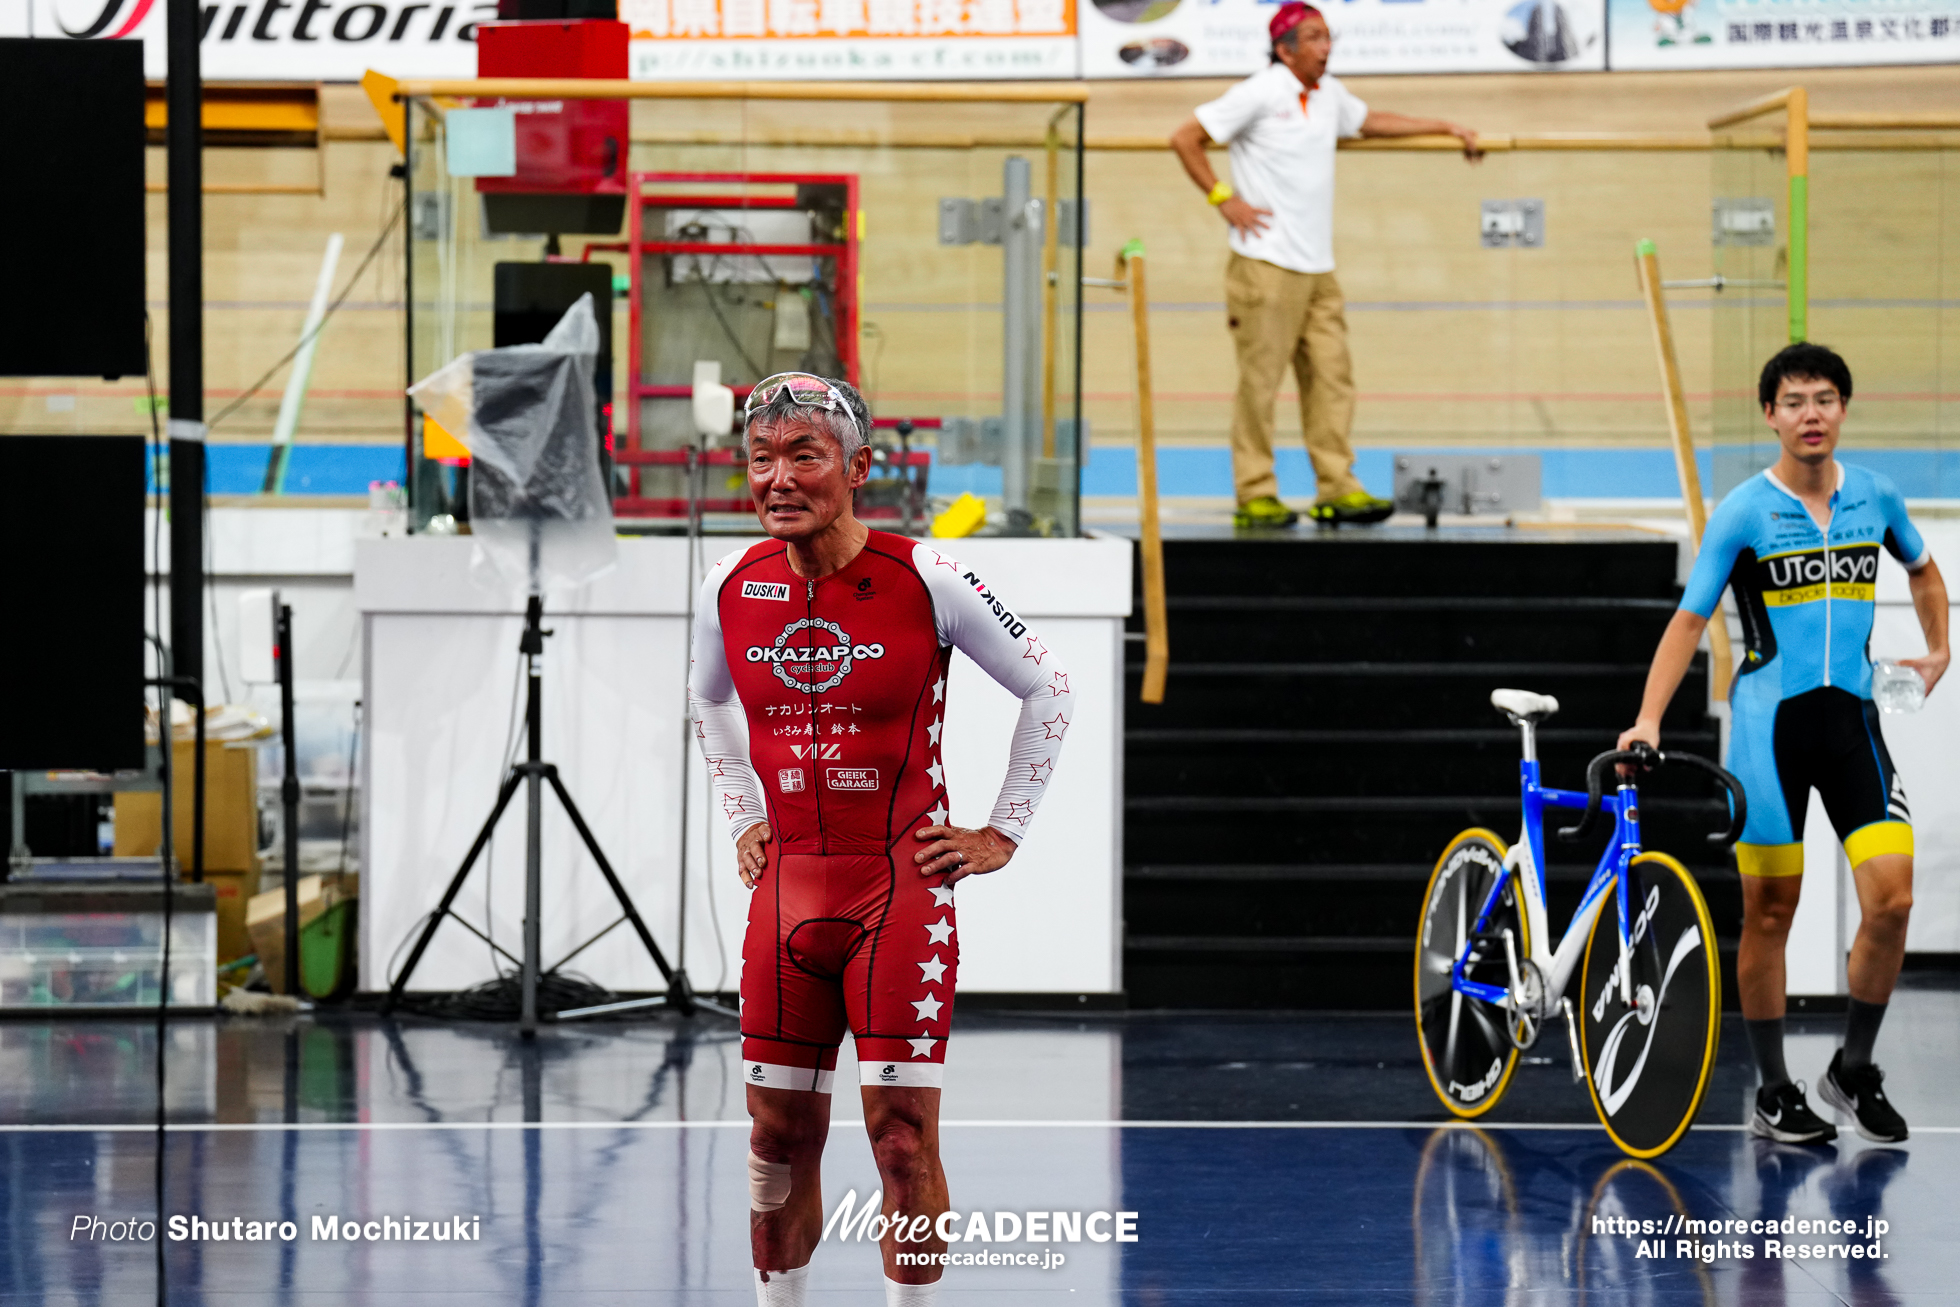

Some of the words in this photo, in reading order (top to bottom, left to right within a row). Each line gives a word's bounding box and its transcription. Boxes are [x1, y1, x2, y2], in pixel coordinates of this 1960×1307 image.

[1728, 18, 1960, 43] 国際観光温泉文化都
[1769, 552, 1876, 586] UTokyo
[815, 662, 835, 673] club
[765, 702, 862, 716] ナカリンオート
[837, 771, 867, 780] GEEK
[831, 780, 875, 789] GARAGE
[1592, 884, 1660, 1023] COMA
